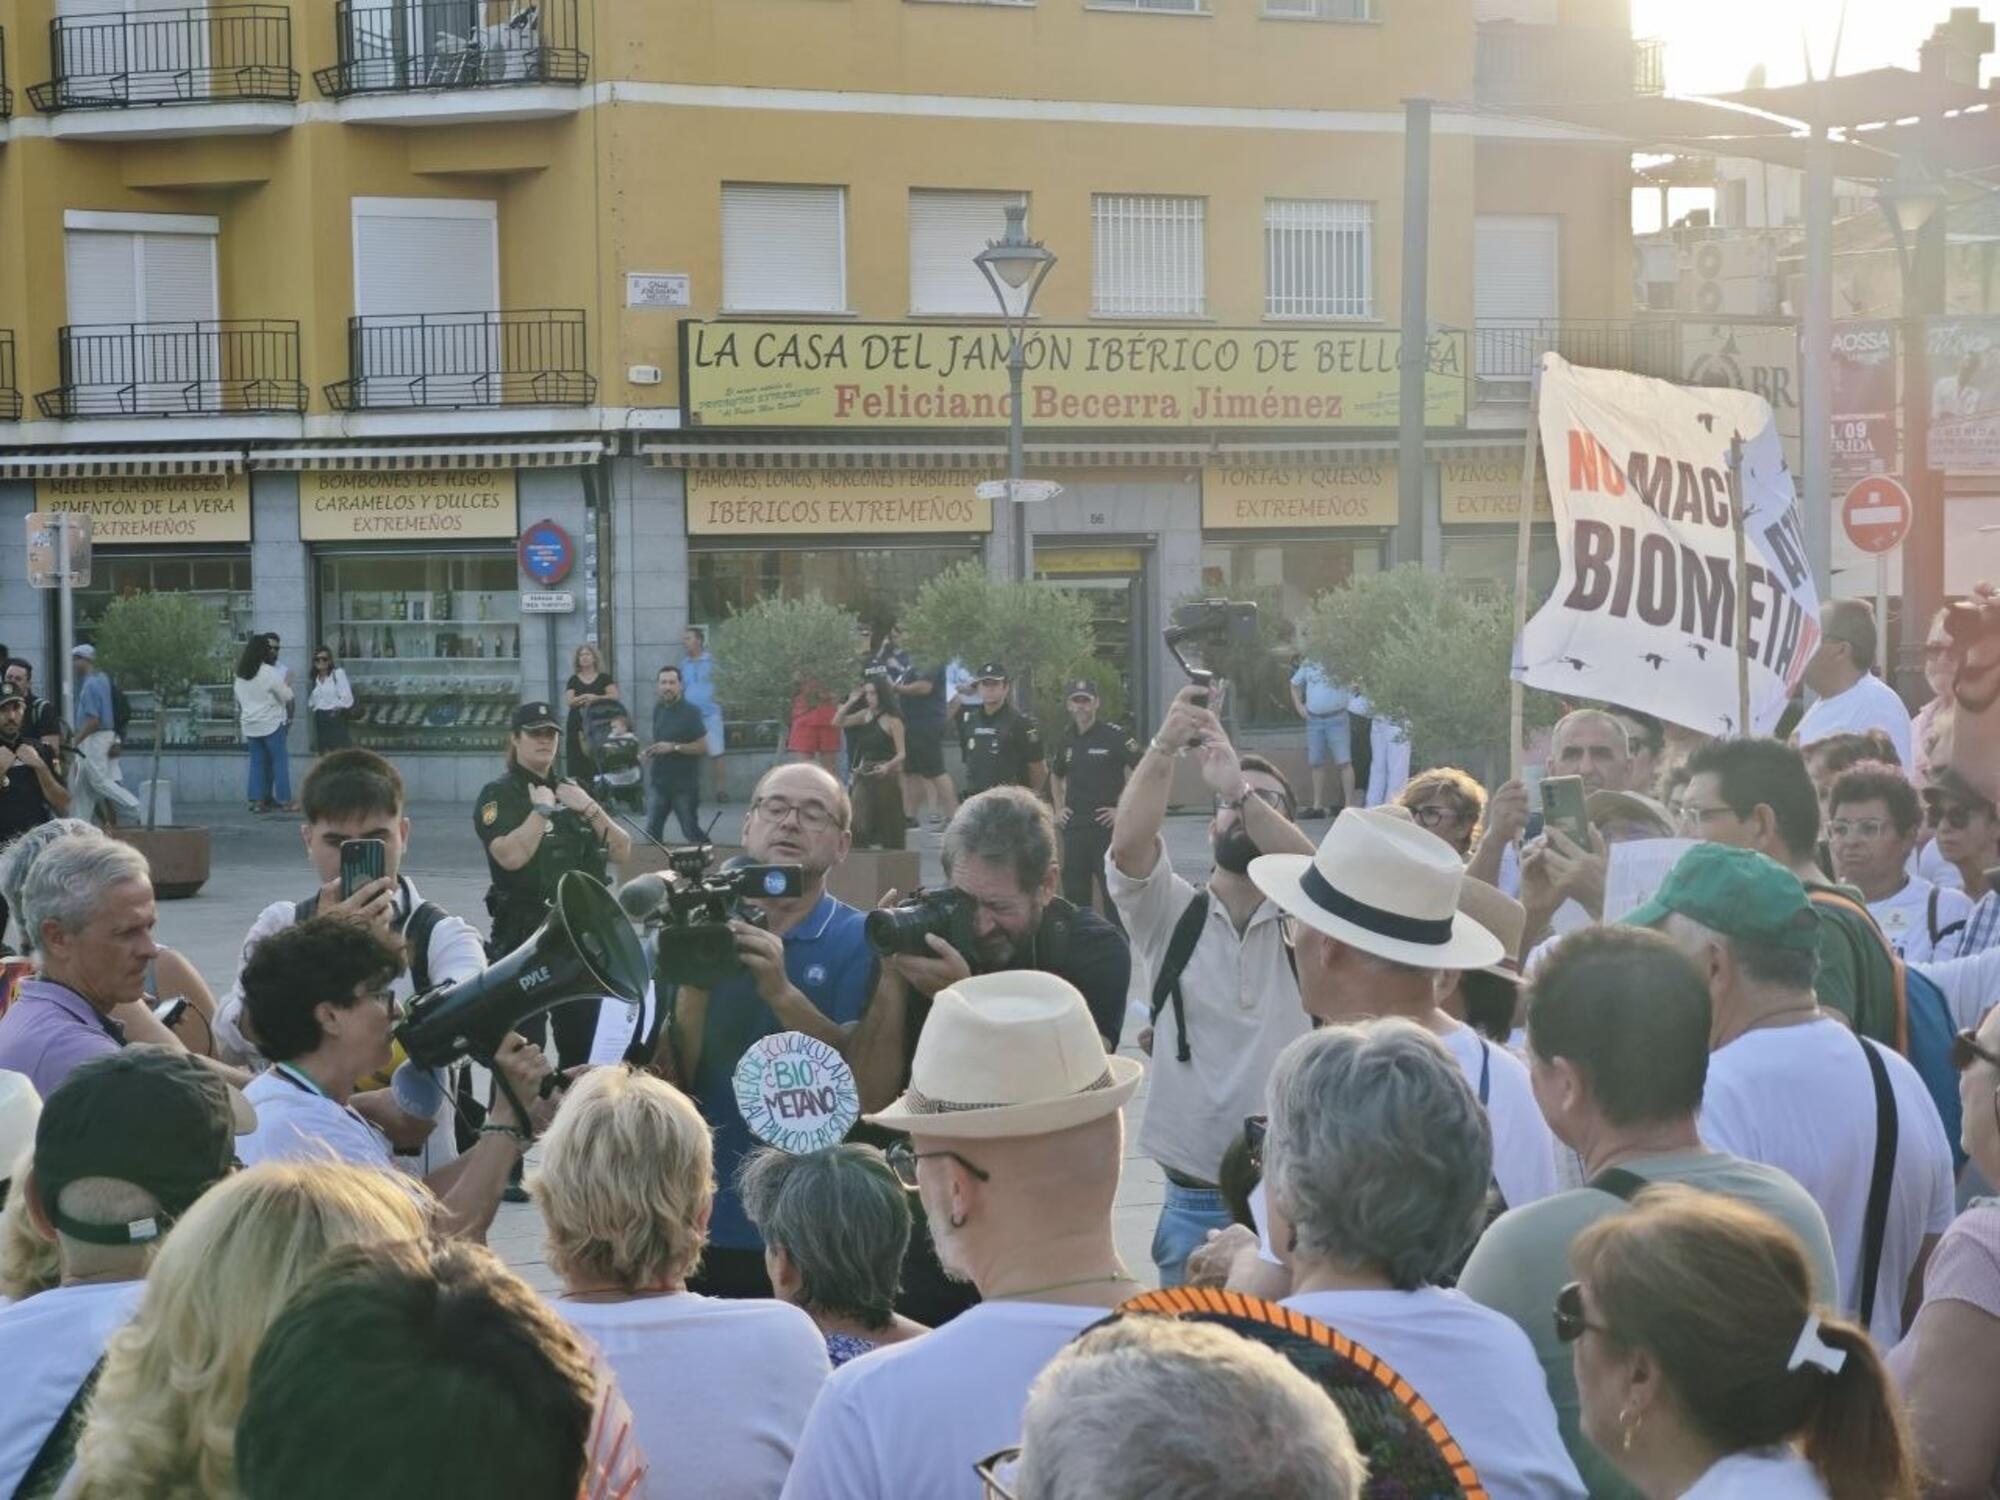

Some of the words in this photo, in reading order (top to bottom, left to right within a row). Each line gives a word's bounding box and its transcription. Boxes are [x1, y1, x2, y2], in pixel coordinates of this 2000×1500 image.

[696, 330, 739, 367] LA
[754, 332, 848, 370] CASA
[861, 333, 932, 370] DEL
[938, 331, 1072, 377] JAMÓN
[1085, 332, 1239, 373] IBÉRICO
[1254, 339, 1299, 373] DE
[1314, 338, 1459, 373] BELLTA
[1032, 385, 1181, 418] Becerra
[1192, 385, 1342, 419] Jiménez
[95, 478, 112, 493] DE
[121, 477, 149, 493] LAS
[319, 472, 411, 489] BOMBONES
[418, 472, 441, 487] DE
[1220, 466, 1291, 486] TORTAS
[1294, 467, 1304, 484] Y
[1310, 466, 1383, 487] QUESOS
[142, 500, 163, 514] DE
[168, 498, 187, 513] LA
[193, 498, 235, 513] VERA
[315, 495, 415, 511] CARAMELOS
[421, 495, 431, 509] Y
[435, 493, 500, 509] DULCES
[708, 496, 820, 524] IBÉRICOS
[829, 496, 974, 523] EXTREMEÑOS
[1235, 495, 1369, 518] EXTREMEÑOS
[91, 518, 196, 536] EXTREMEÑOS
[353, 514, 463, 532] EXTREMEÑOS
[519, 966, 552, 992] PYLE
[764, 1086, 837, 1120] METANO
